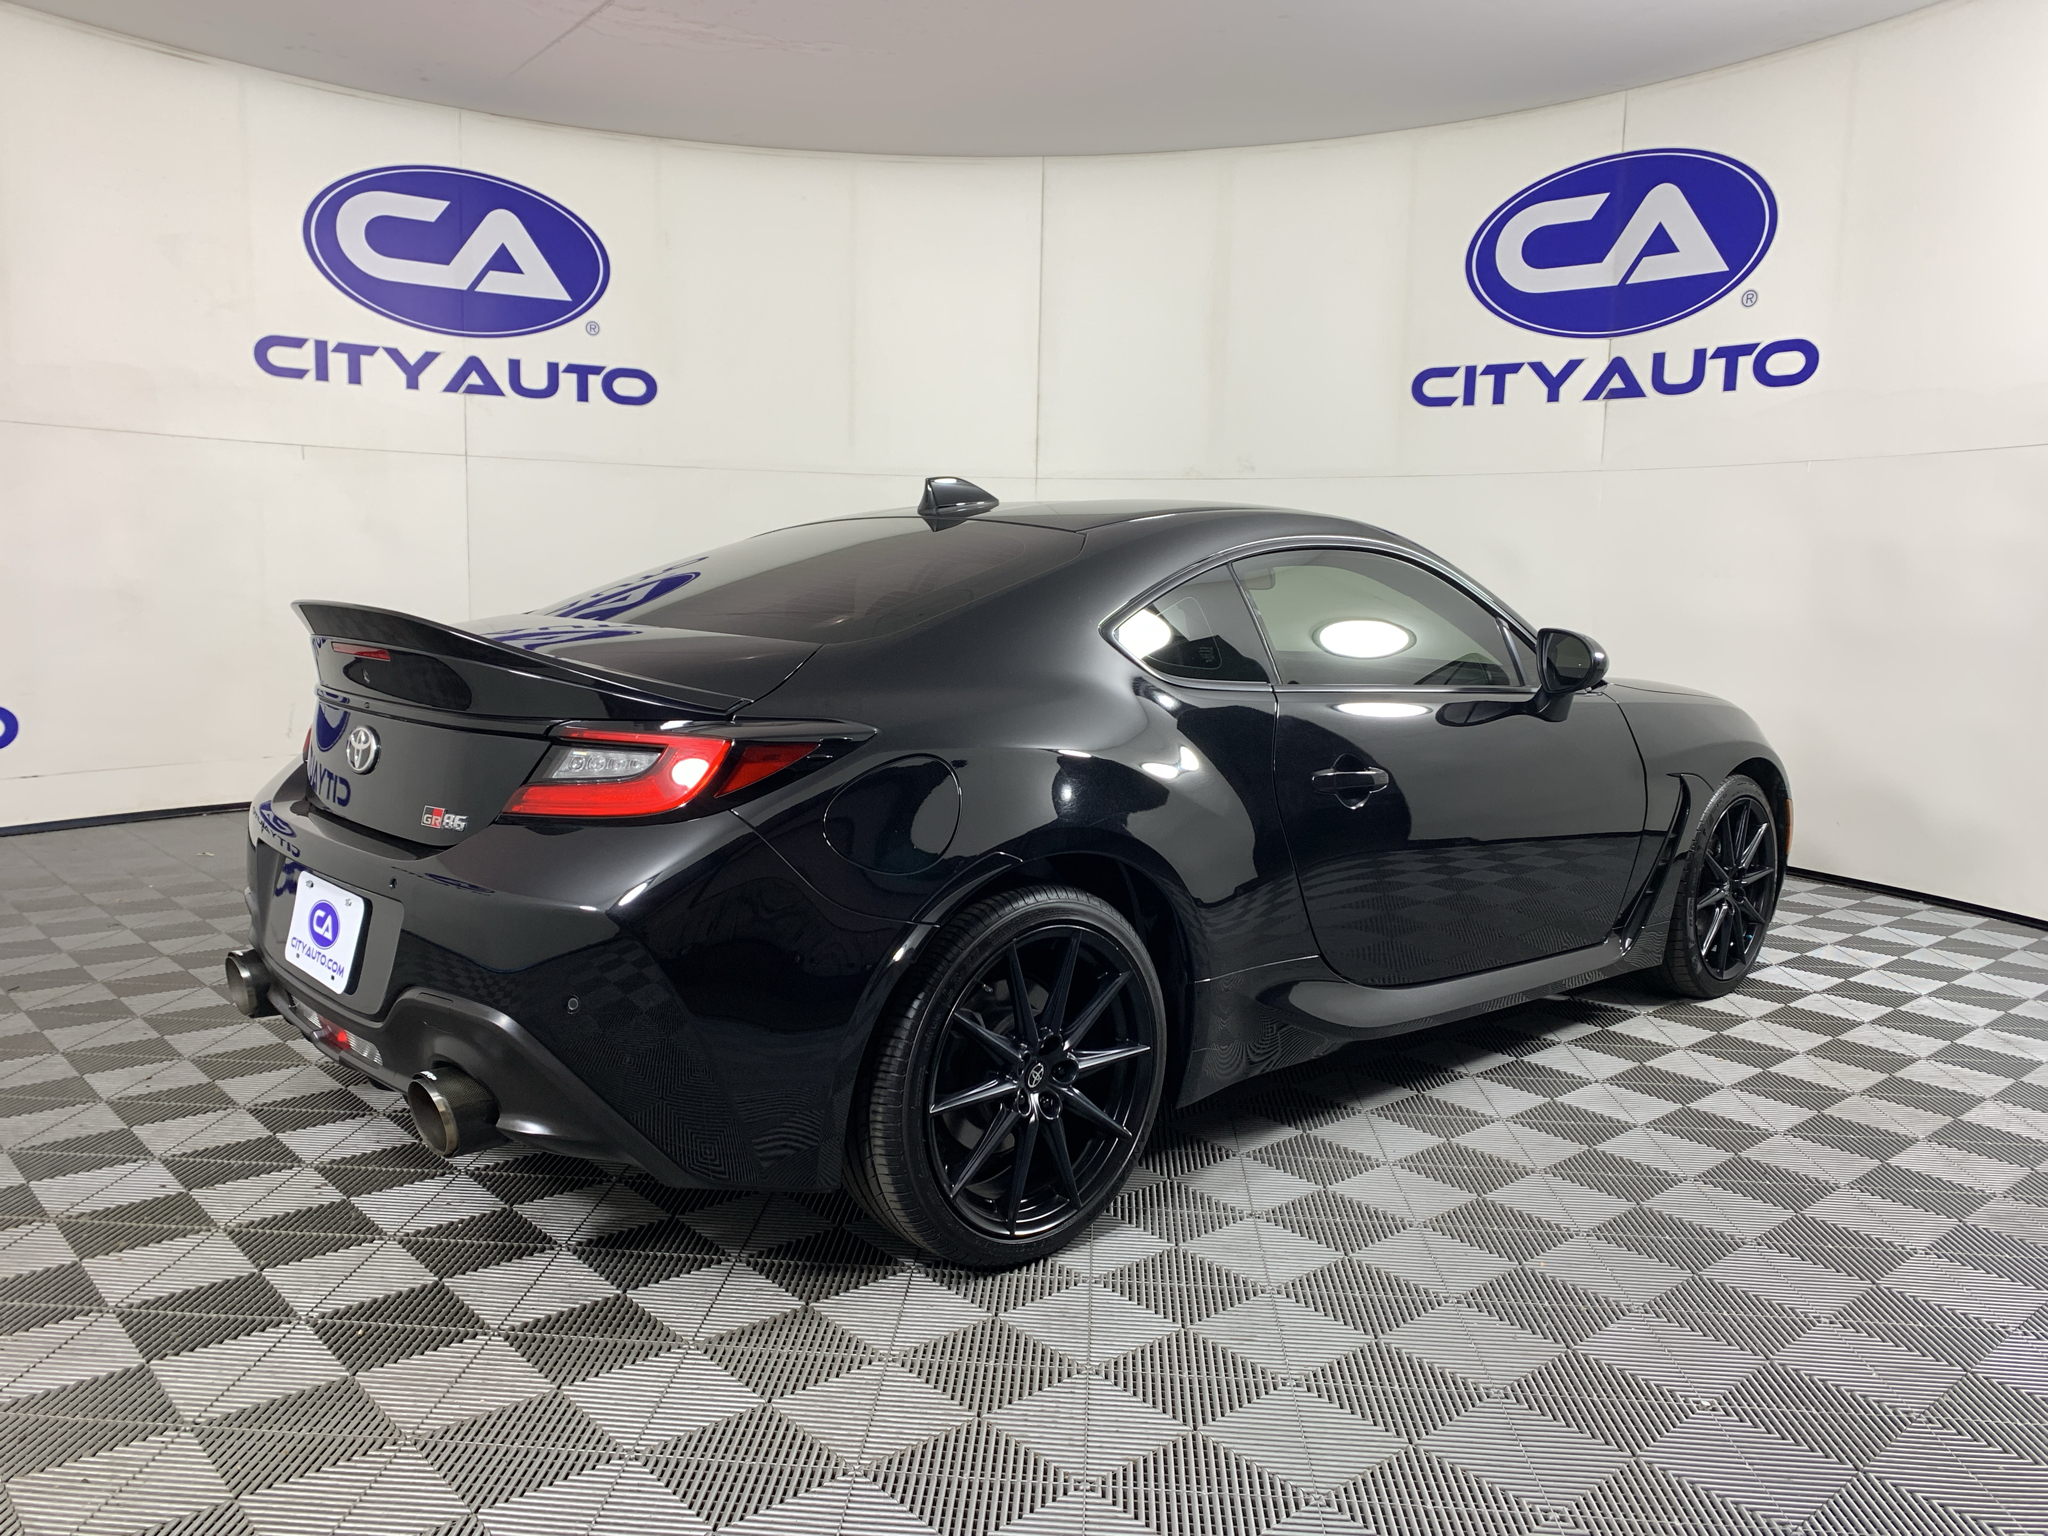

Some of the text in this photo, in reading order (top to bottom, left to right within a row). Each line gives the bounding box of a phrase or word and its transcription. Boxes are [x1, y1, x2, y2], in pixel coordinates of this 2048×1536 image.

[335, 190, 572, 302] CA
[1495, 182, 1730, 294] CA
[253, 334, 658, 406] CITY AUTO
[1410, 337, 1820, 408] CITY AUTO
[290, 936, 345, 978] CITYAUTO.COM
[312, 908, 333, 941] CA
